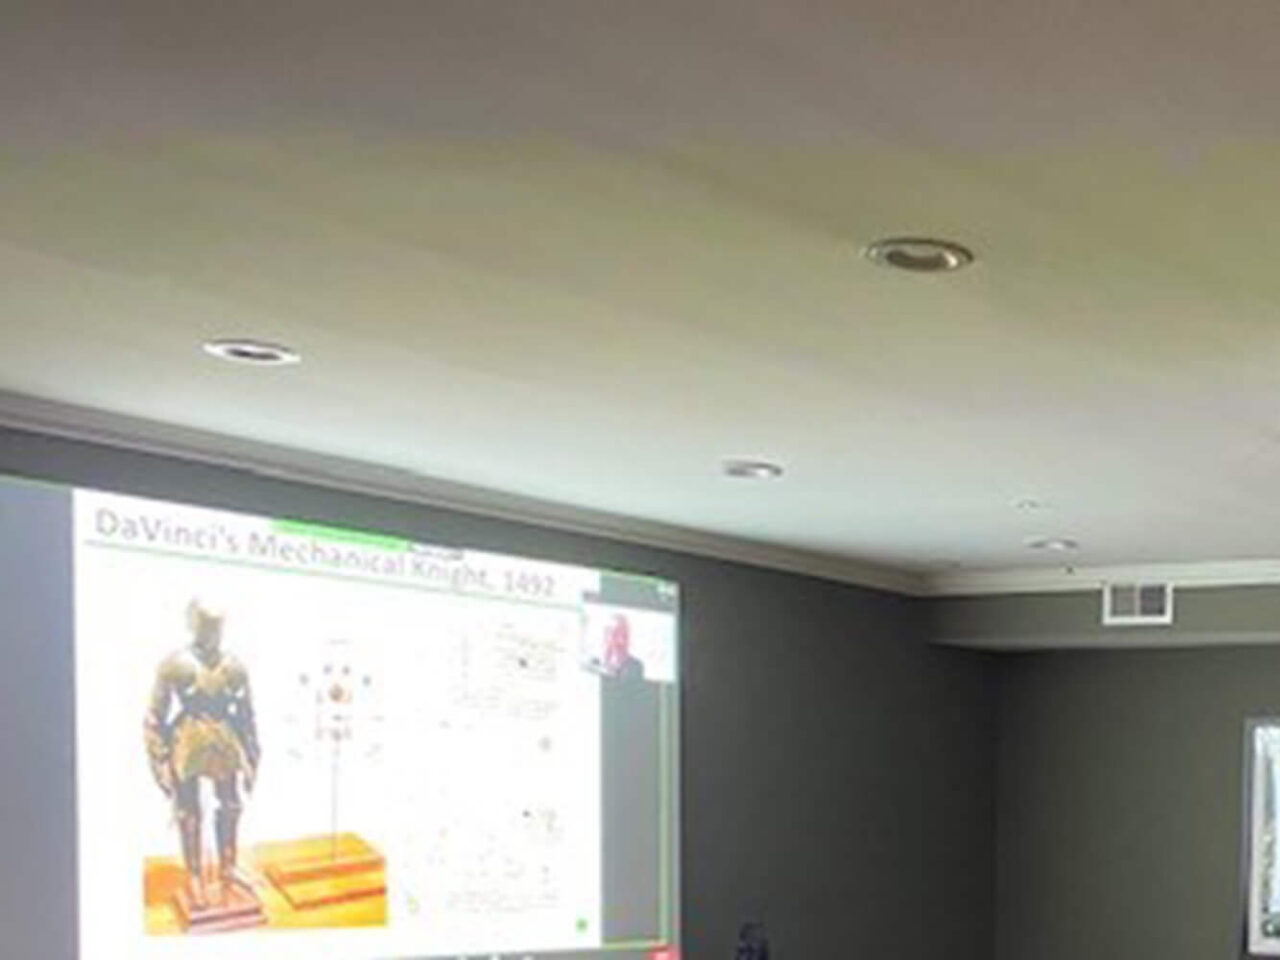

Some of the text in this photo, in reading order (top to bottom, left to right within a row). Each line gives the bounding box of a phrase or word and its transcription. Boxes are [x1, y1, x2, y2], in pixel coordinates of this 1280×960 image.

[94, 506, 239, 554] DaVinci's
[249, 531, 405, 576] Mechanical
[505, 569, 556, 597] 1492
